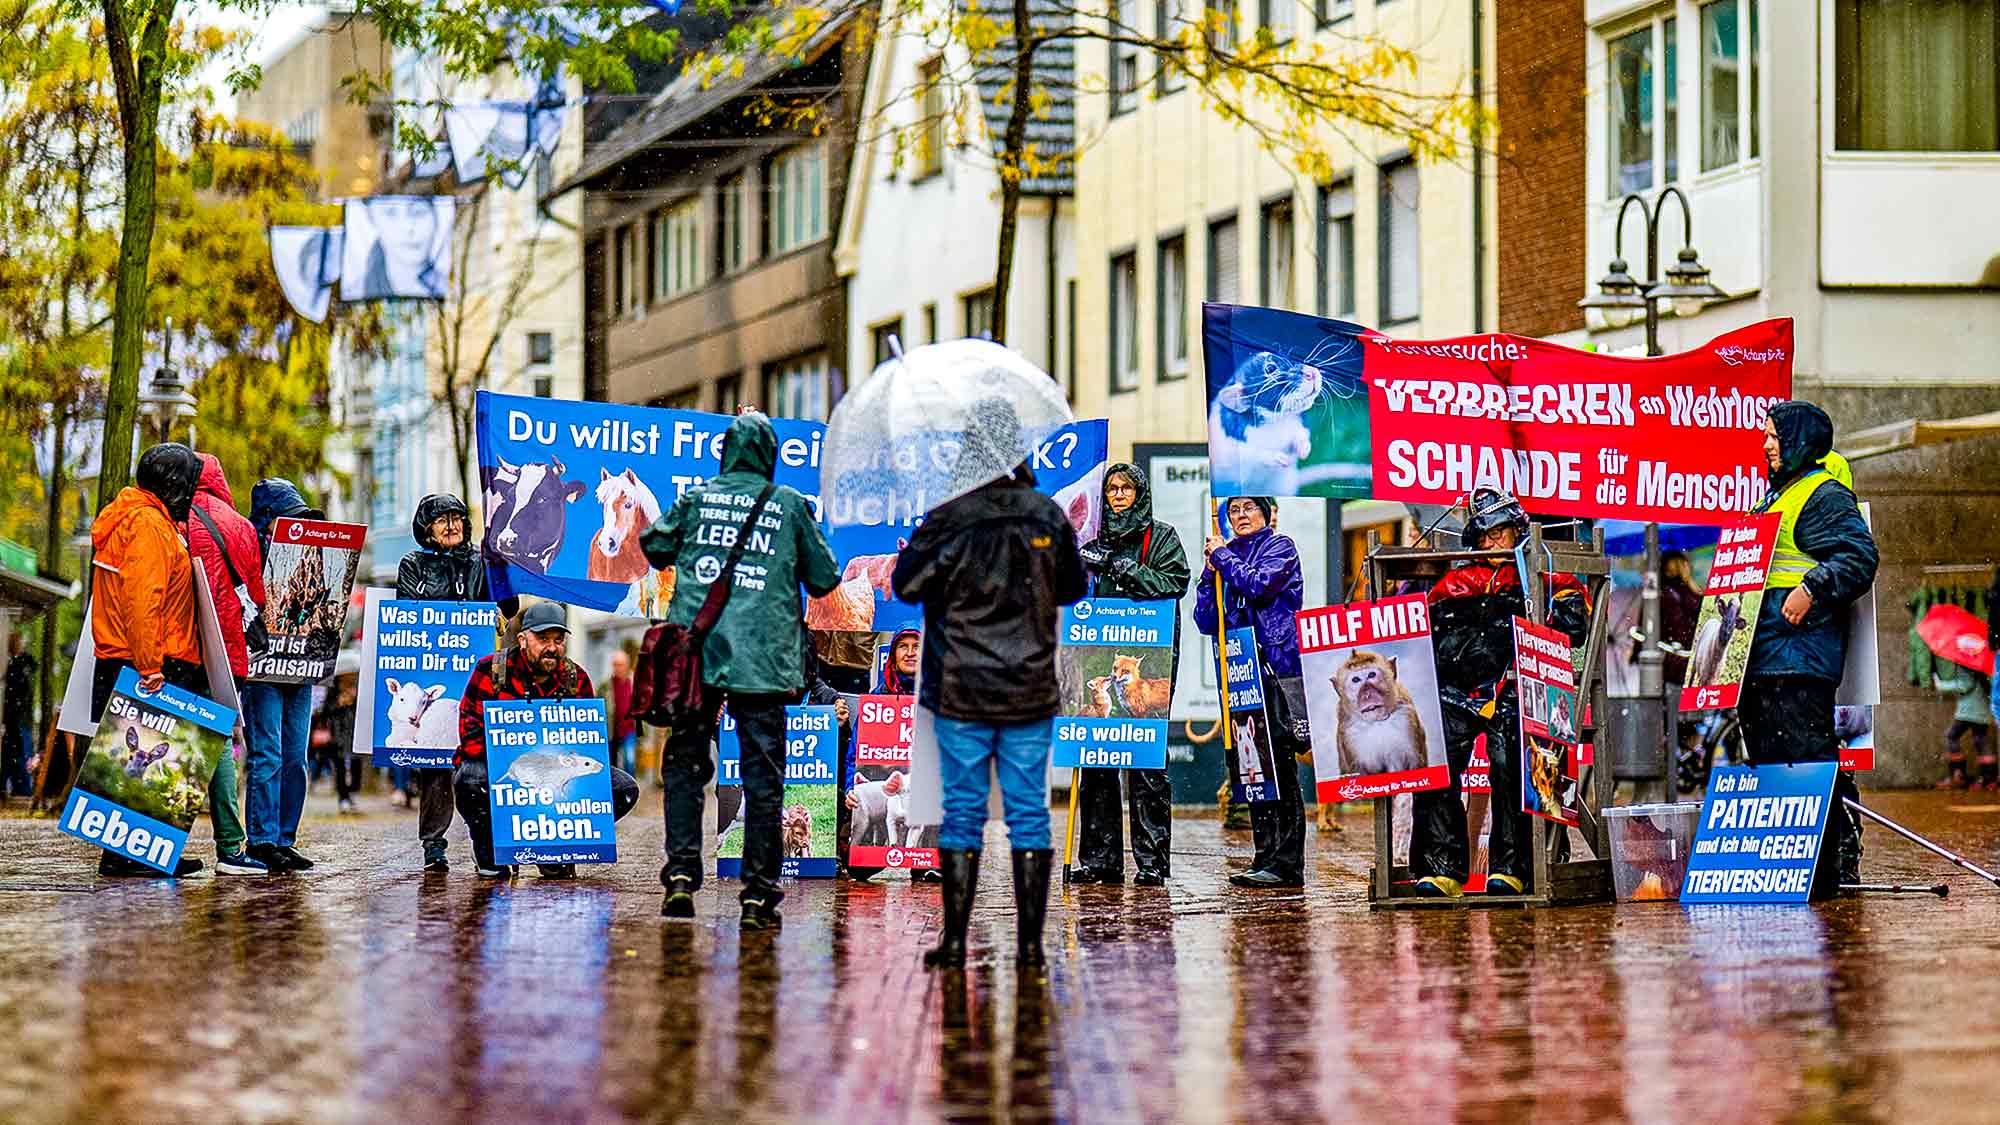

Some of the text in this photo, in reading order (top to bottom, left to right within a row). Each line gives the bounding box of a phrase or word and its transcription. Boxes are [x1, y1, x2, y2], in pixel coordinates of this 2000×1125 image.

[1374, 378, 1634, 425] VERBRECHEN
[1639, 395, 1665, 415] an
[508, 410, 557, 445] Du
[570, 419, 661, 454] willst
[1388, 440, 1581, 500] SCHANDE
[1598, 448, 1629, 475] für
[702, 493, 733, 506] TIERE
[1595, 479, 1627, 505] die
[699, 508, 730, 521] TIERE
[696, 524, 776, 556] LEBN.
[734, 572, 766, 590] Tiere
[380, 606, 496, 626] Was Du nicht
[1096, 607, 1156, 617] Achtung für Tiere
[1069, 624, 1158, 643] Sie fühlen
[1300, 601, 1428, 649] HILF MIR
[288, 637, 307, 655] ist
[380, 630, 470, 651] willst, das
[379, 655, 417, 670] man
[422, 654, 447, 671] Dir
[109, 696, 177, 735] Sie will
[156, 690, 217, 721] Achtung für Tiere
[486, 706, 605, 724] Tiere fühlen.
[862, 702, 895, 723] Sie
[489, 728, 606, 746] Tiere leiden.
[1058, 723, 1156, 743] sie wollen
[1080, 748, 1132, 765] leben
[1363, 785, 1390, 795] Achtung
[1715, 774, 1759, 792] Ich bin
[491, 784, 612, 815] Tiere wollen
[1707, 796, 1822, 829] PATIENTIN
[67, 796, 176, 867] leben
[512, 814, 602, 841] leben.
[1695, 835, 1818, 860] und ich bin GEGEN
[1687, 868, 1811, 894] TIERVERSUCHE
